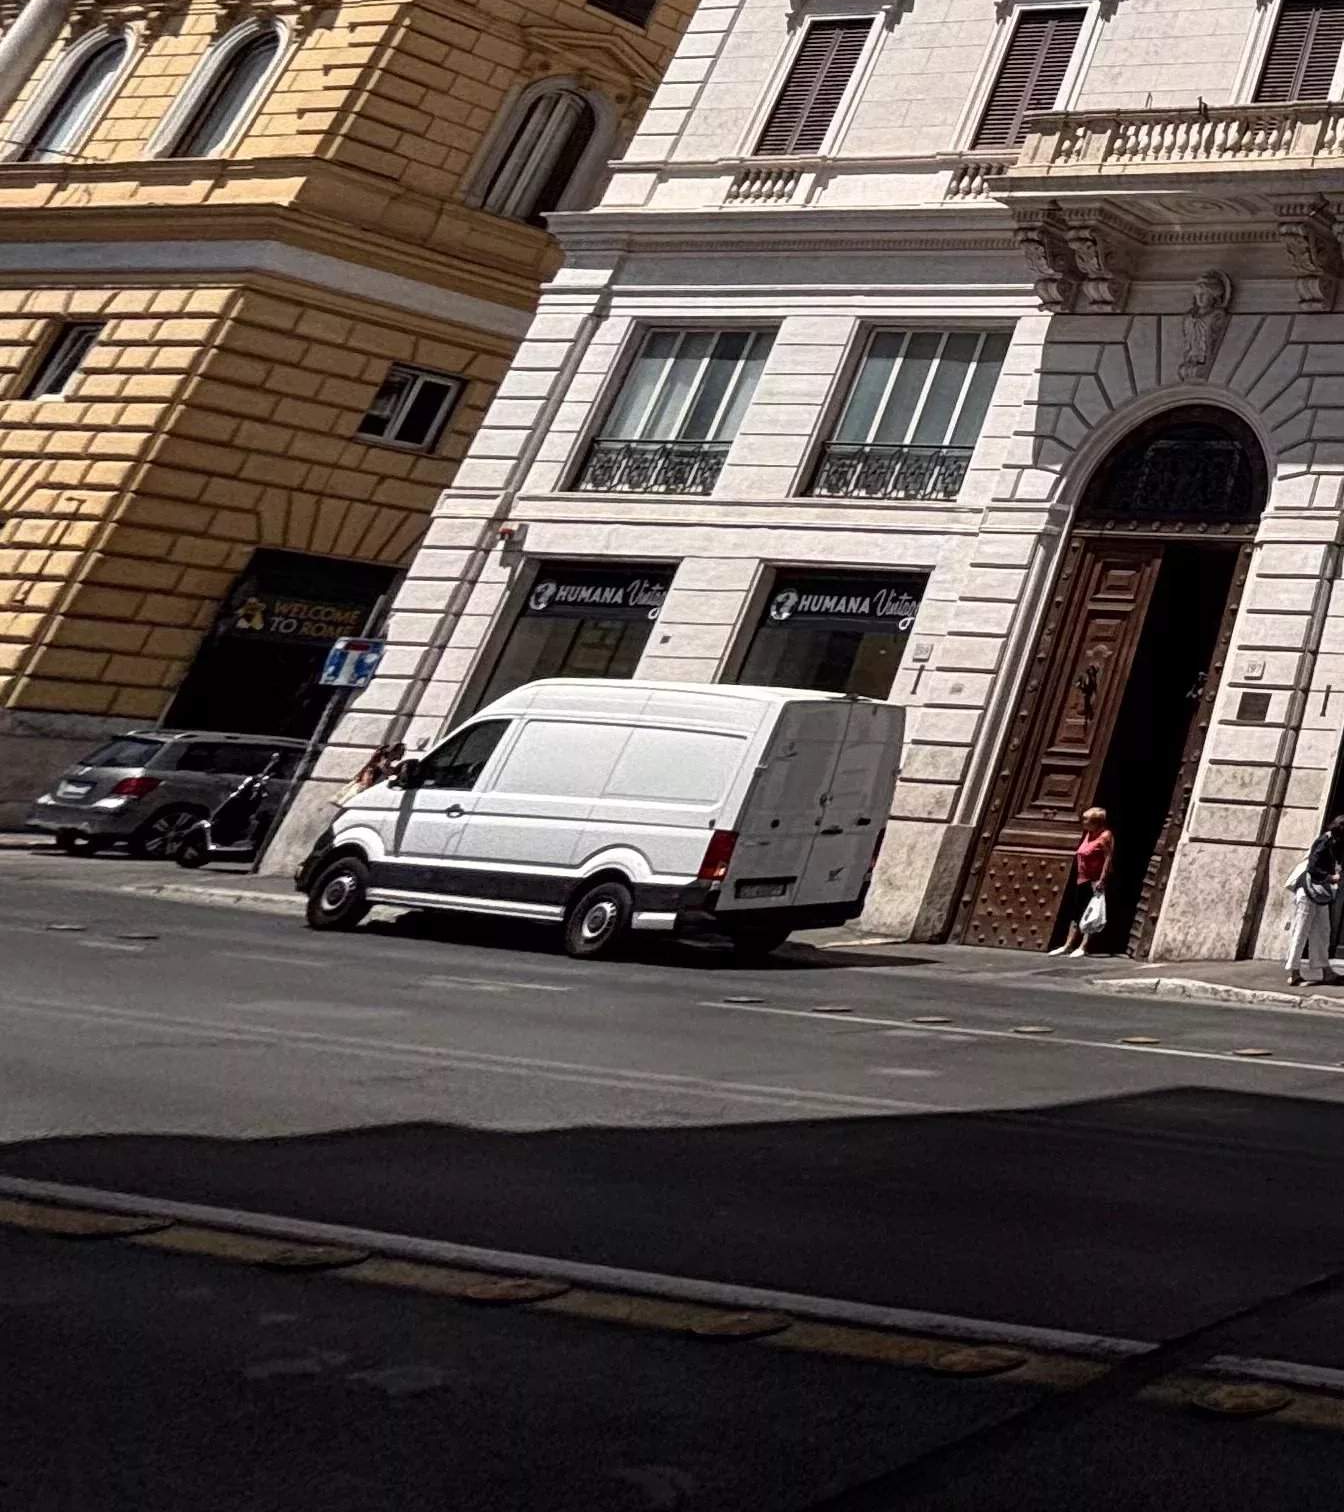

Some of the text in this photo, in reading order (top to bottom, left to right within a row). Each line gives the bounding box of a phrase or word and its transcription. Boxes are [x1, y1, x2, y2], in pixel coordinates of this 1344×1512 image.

[555, 585, 624, 605] HUMANA
[797, 594, 871, 614] HUMANA
[273, 600, 361, 626] WELCOME
[269, 616, 355, 638] TO ROME
